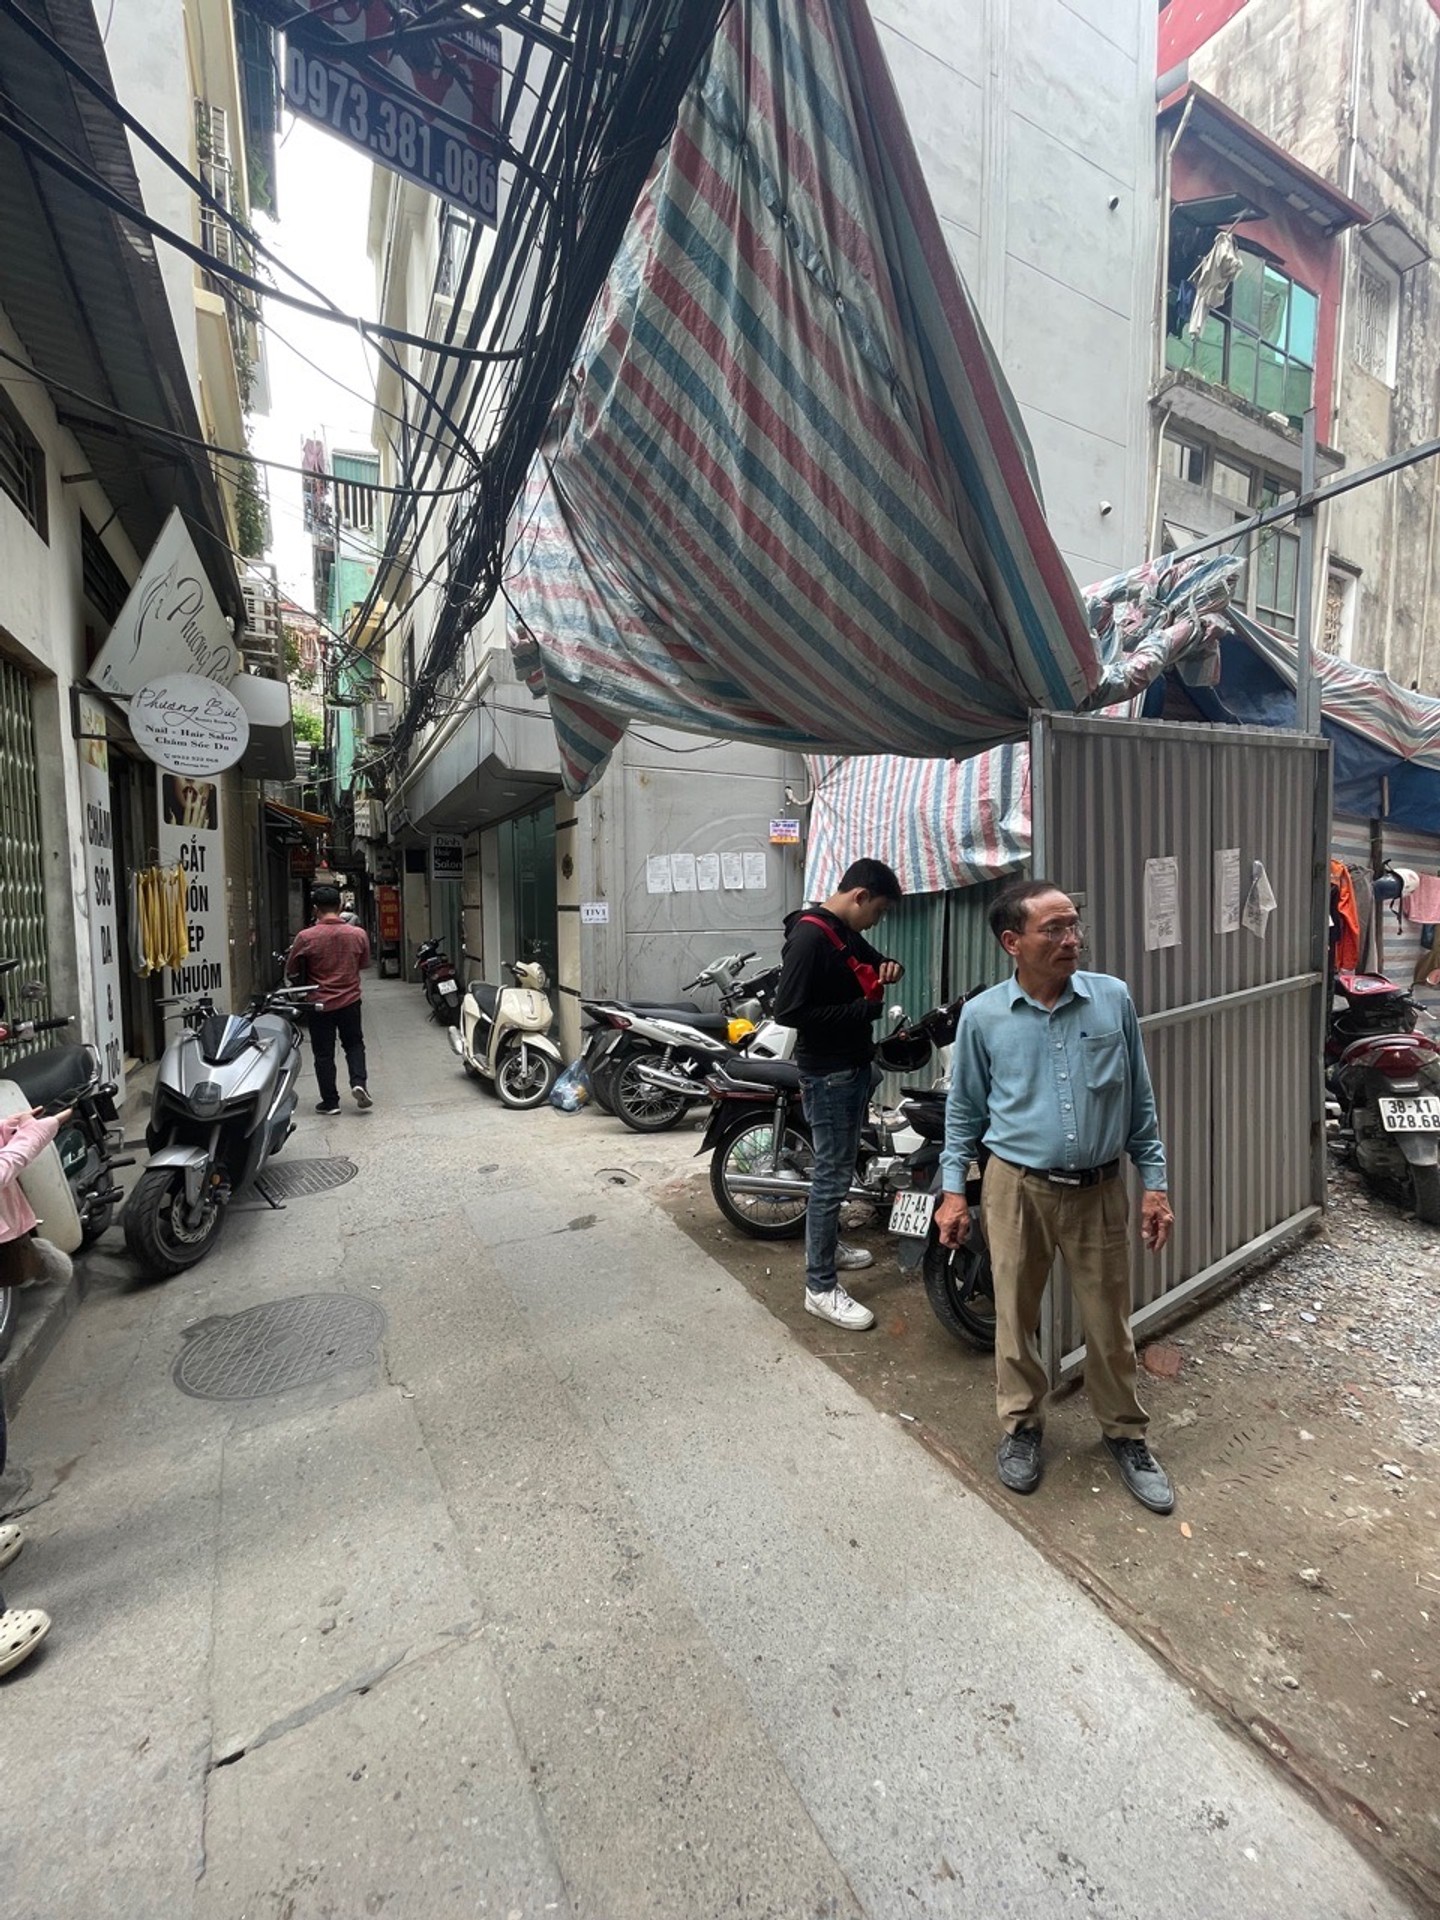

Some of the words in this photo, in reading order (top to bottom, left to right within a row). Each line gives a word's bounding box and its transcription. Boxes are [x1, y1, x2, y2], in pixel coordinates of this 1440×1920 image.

[287, 47, 496, 213] 0973.381.086
[145, 724, 168, 734] Nail
[181, 729, 205, 738] Hair
[208, 732, 238, 742] Salon
[191, 740, 209, 749] Sóc
[214, 742, 229, 751] Da
[180, 834, 206, 873] CẮT
[95, 858, 111, 906] SÓC
[100, 926, 113, 965] DA
[171, 959, 222, 997] NHUỘM
[1388, 1099, 1431, 1114] 38-X1
[1387, 1115, 1440, 1128] 028.68
[900, 1193, 928, 1214] 17-AA
[891, 1211, 928, 1234] 876.42
